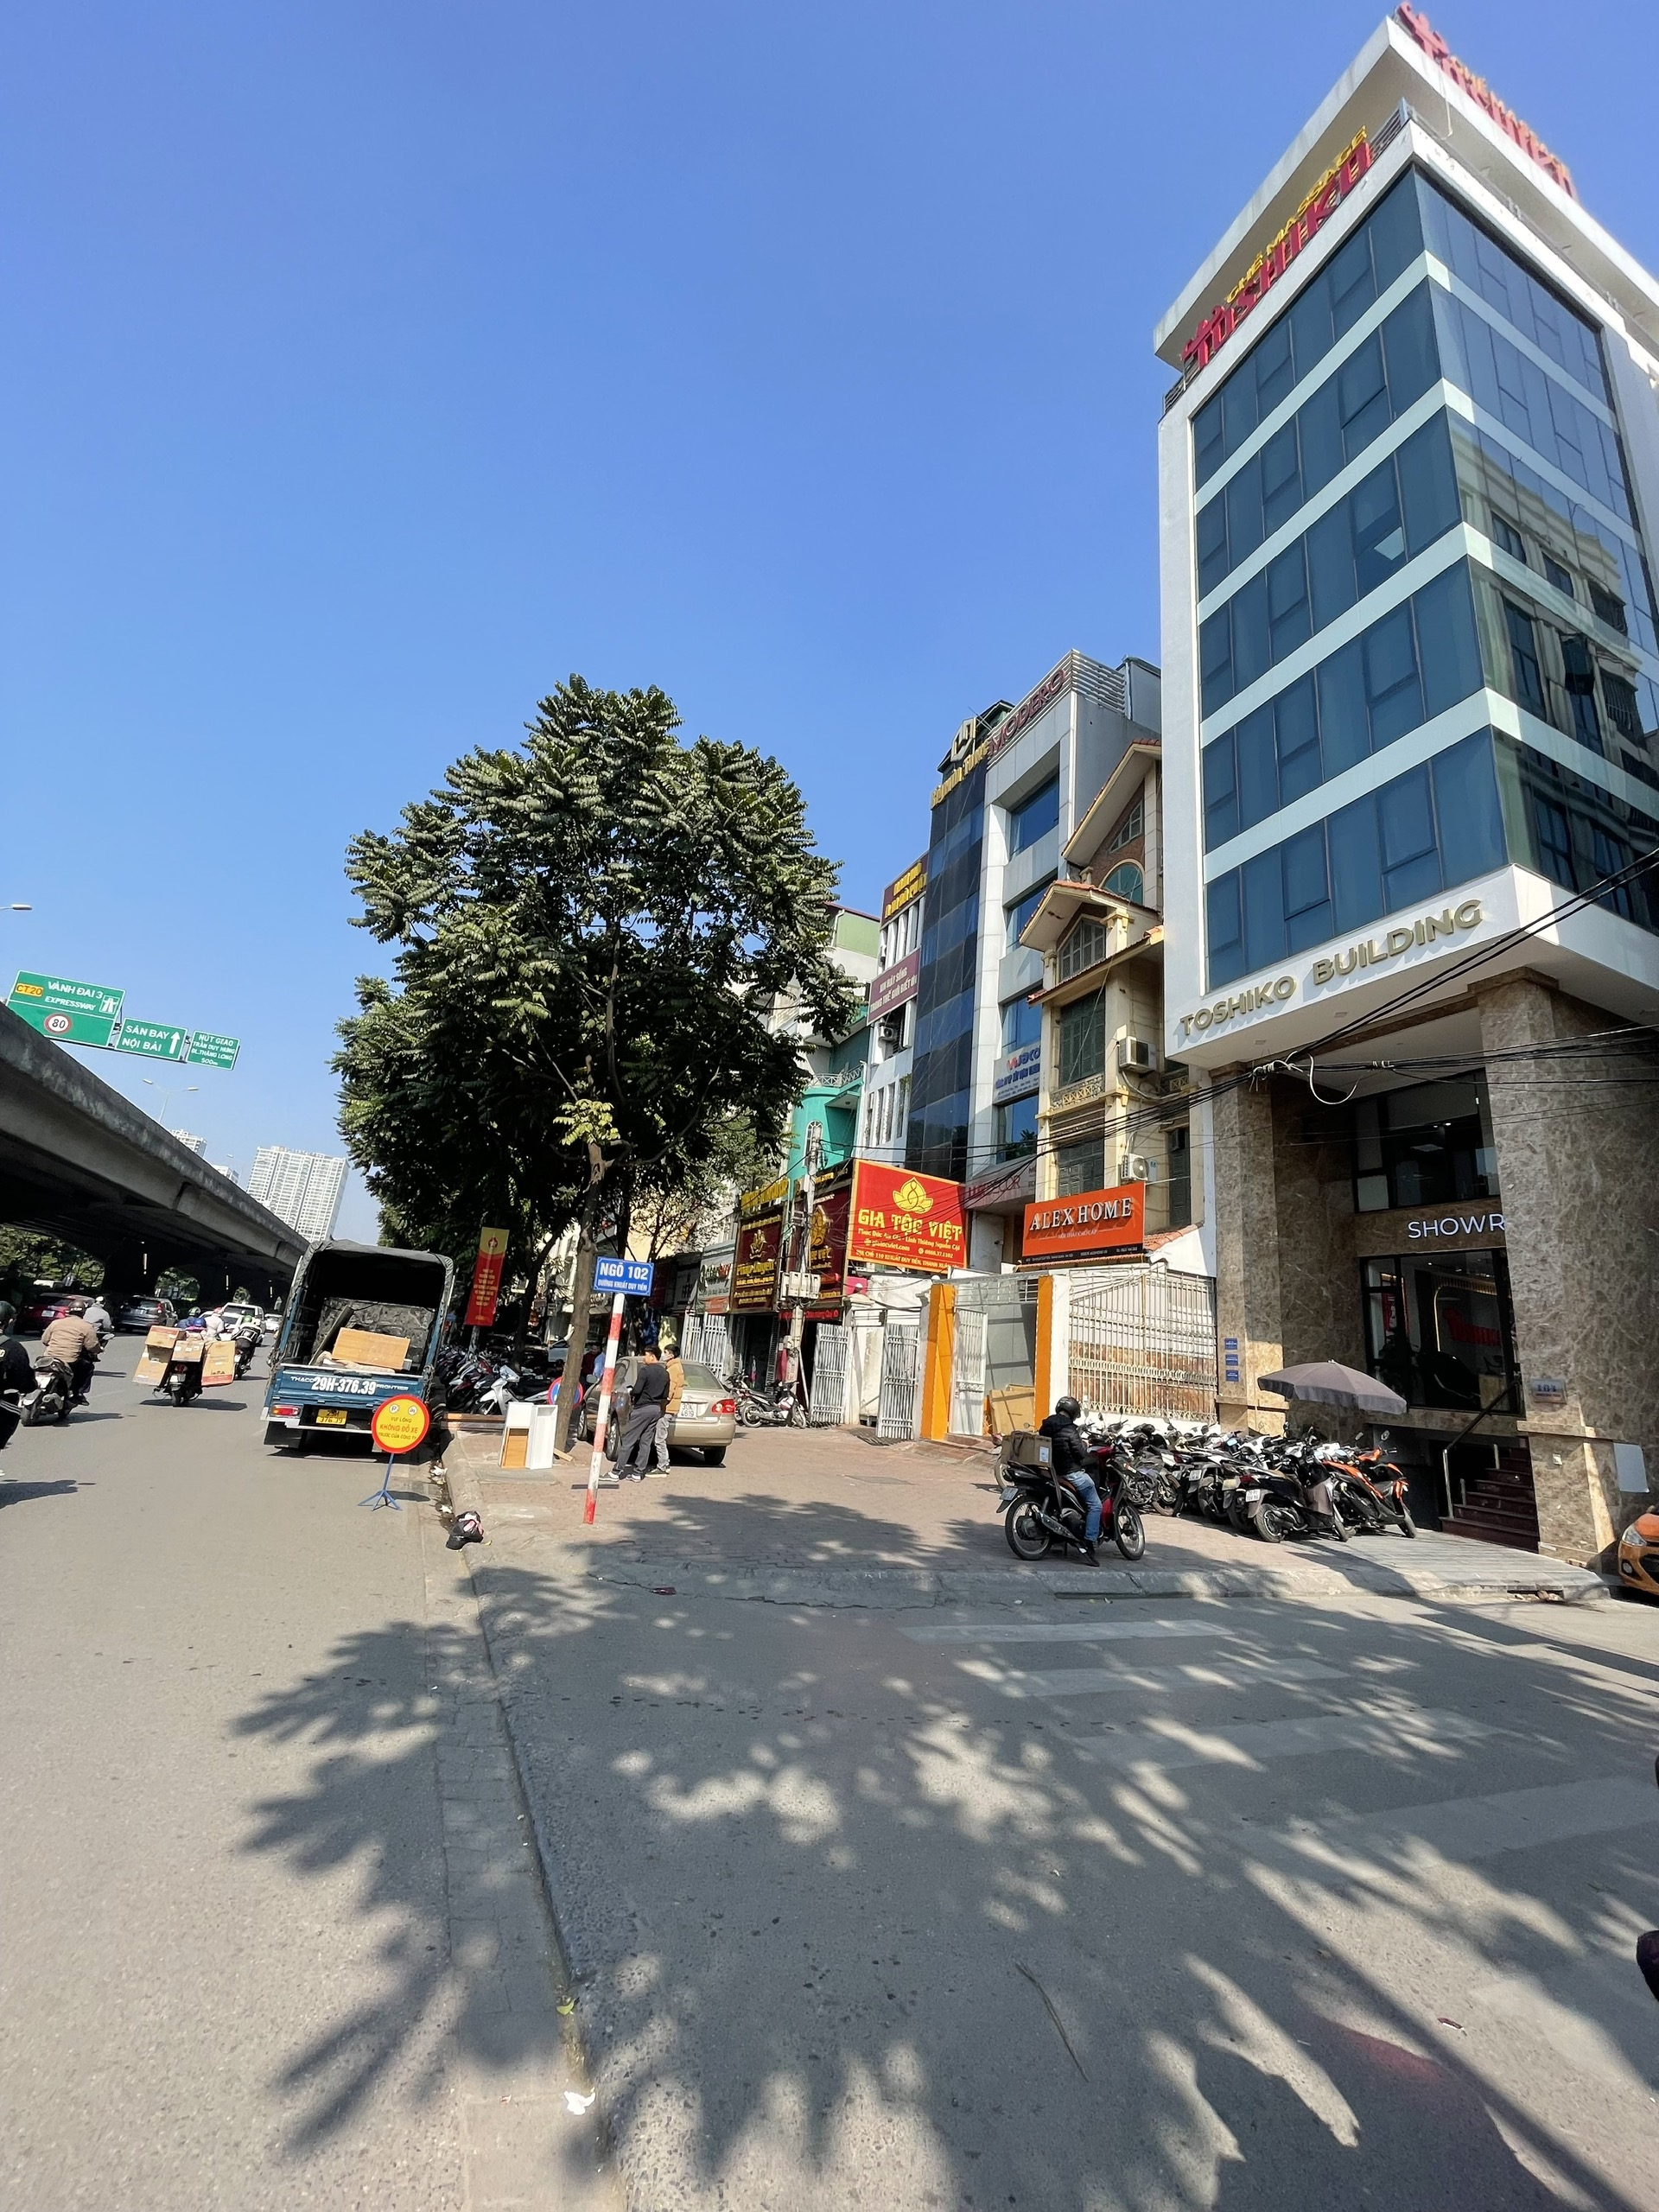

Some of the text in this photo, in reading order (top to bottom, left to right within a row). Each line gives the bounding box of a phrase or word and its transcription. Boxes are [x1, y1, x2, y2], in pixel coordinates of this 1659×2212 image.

[1266, 125, 1367, 256] MASSAGE
[1179, 899, 1484, 1036] TOSHIKO BUILDING
[48, 981, 76, 995] VÀNH
[76, 987, 96, 998] ĐAI
[44, 995, 97, 1011] EXPRESSWAY
[52, 1019, 67, 1029] 80
[125, 1025, 170, 1040] SÂN BAY
[122, 1037, 162, 1052] NỘI BÀI
[215, 1037, 234, 1047] GIAO
[858, 1209, 963, 1243] GIA TỘC VIỆT
[600, 1262, 649, 1280] NGÕ 102
[311, 1376, 377, 1395] 29H-376.39
